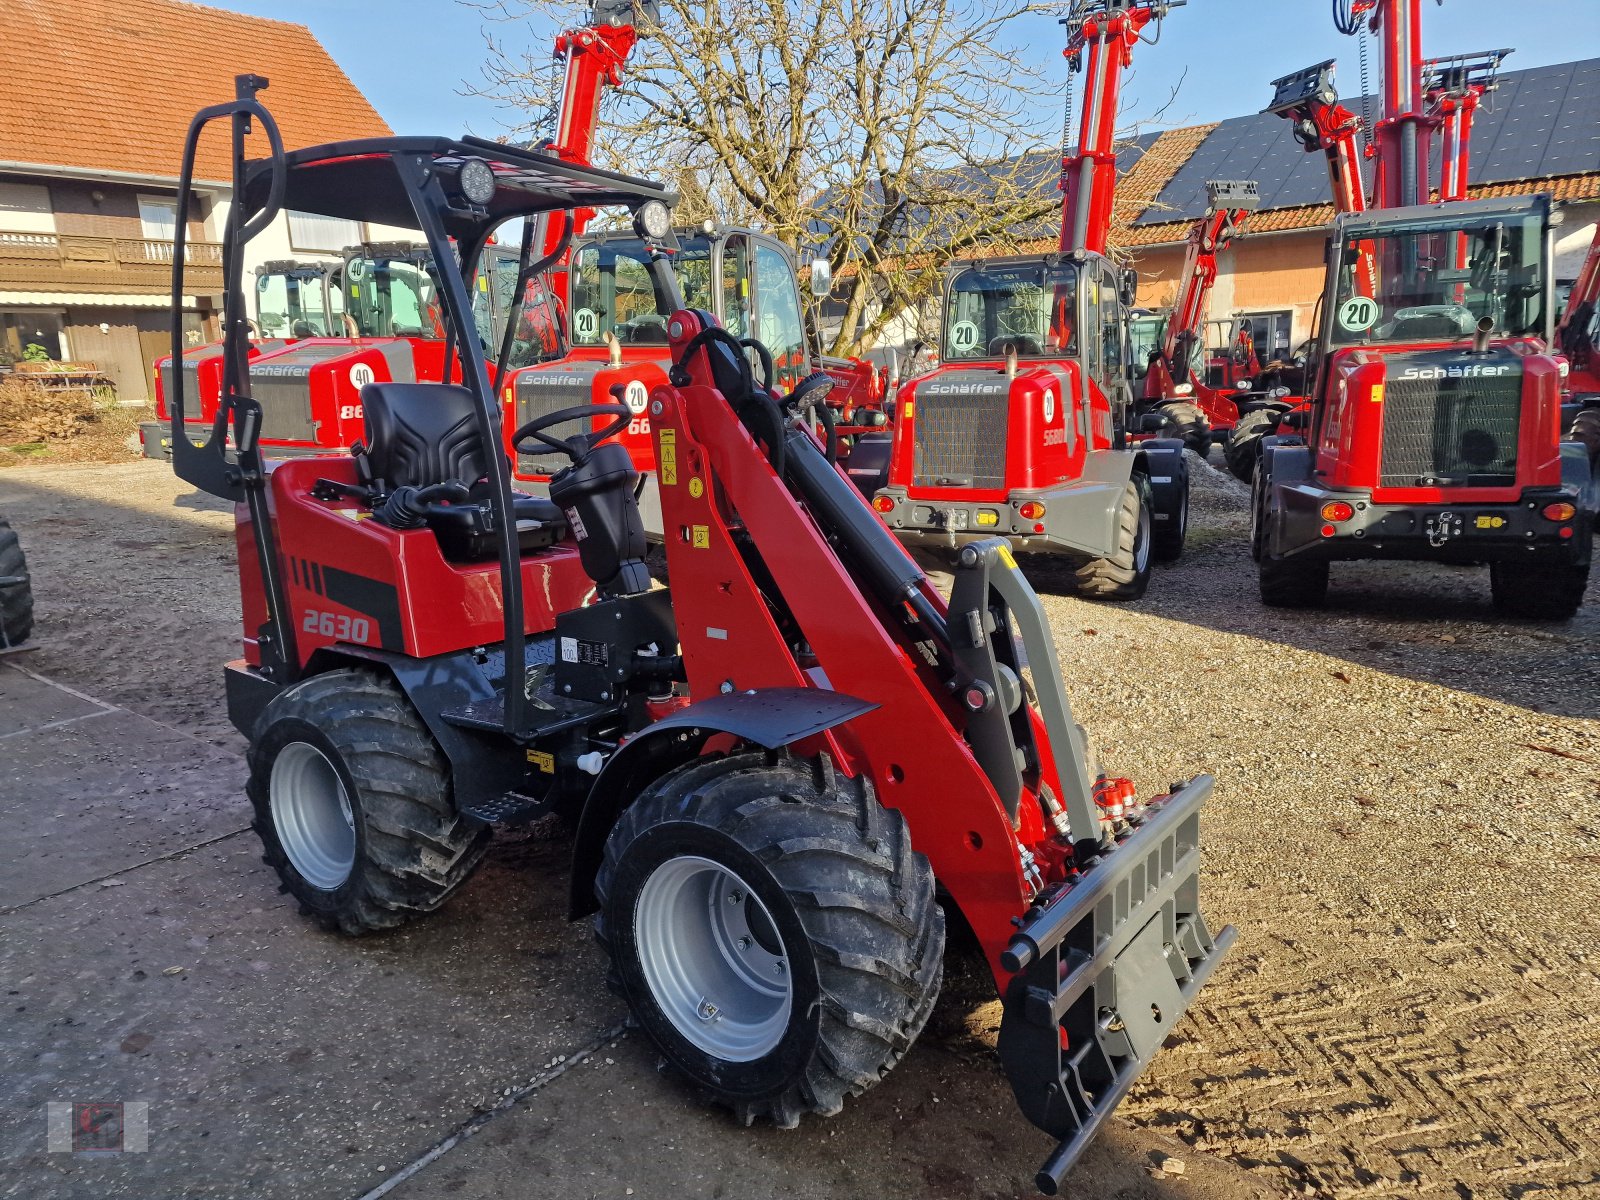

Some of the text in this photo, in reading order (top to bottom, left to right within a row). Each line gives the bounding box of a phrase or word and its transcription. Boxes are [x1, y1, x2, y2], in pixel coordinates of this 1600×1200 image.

[351, 262, 362, 277] 40
[1346, 303, 1369, 324] 20
[579, 313, 593, 332] 20
[955, 326, 973, 346] 20
[249, 365, 310, 377] Schäffer
[355, 369, 370, 385] 40
[1397, 365, 1510, 380] Schäffer
[521, 375, 584, 386] Schäffer
[925, 383, 1002, 394] Schäffer
[631, 387, 644, 407] 20
[302, 609, 369, 643] 2630
